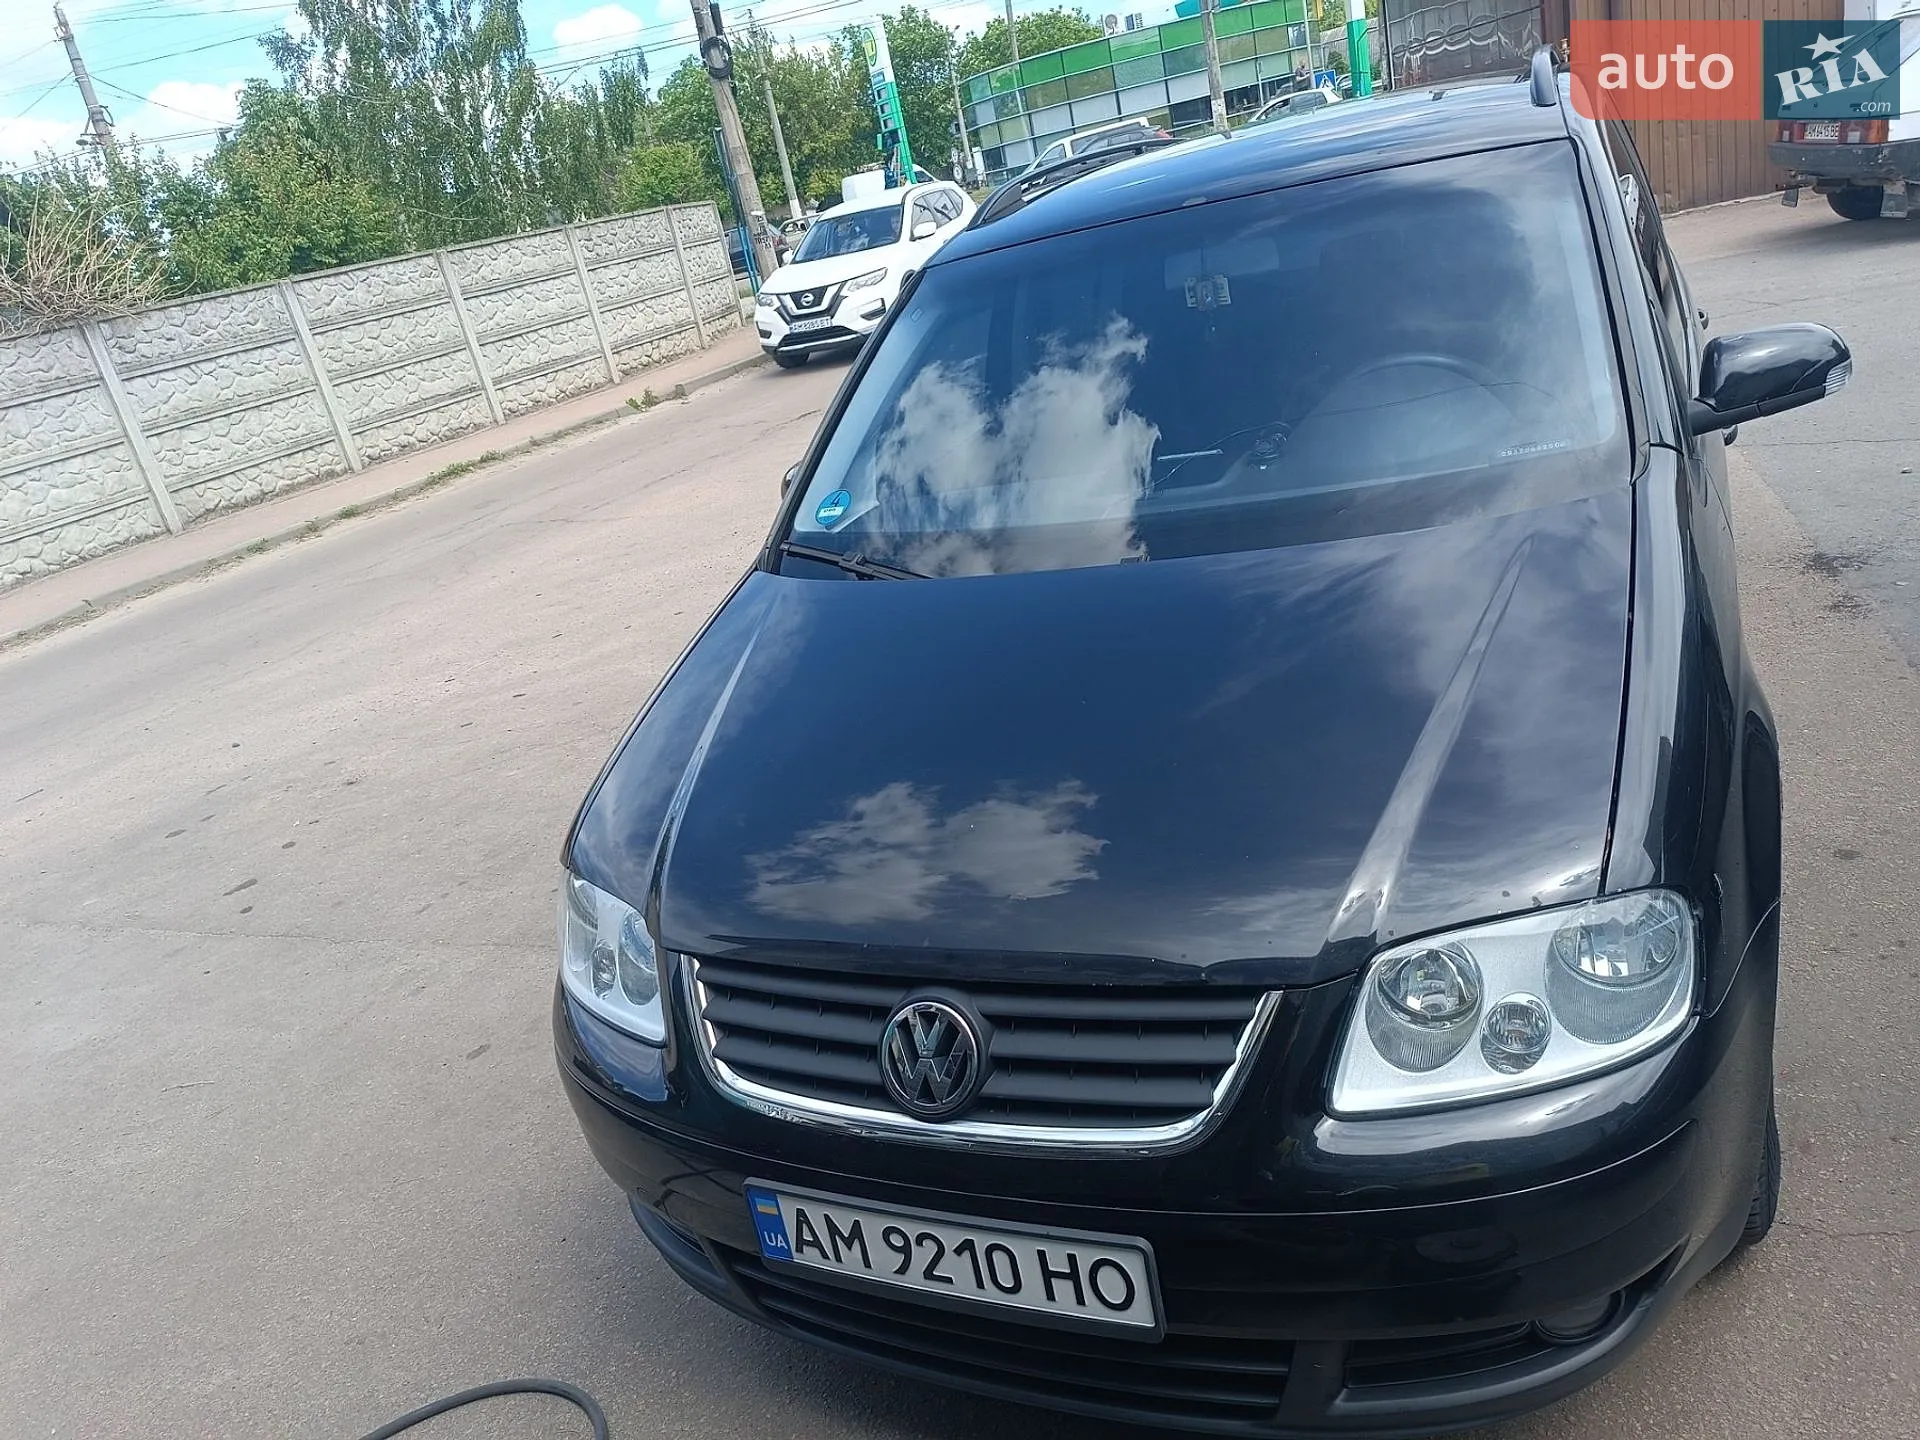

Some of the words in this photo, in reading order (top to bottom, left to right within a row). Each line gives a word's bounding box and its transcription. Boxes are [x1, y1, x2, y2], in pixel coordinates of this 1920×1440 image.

[765, 1230, 787, 1250] UA
[794, 1207, 872, 1269] AM
[881, 1225, 1023, 1295] 9210
[1036, 1249, 1136, 1311] HO
